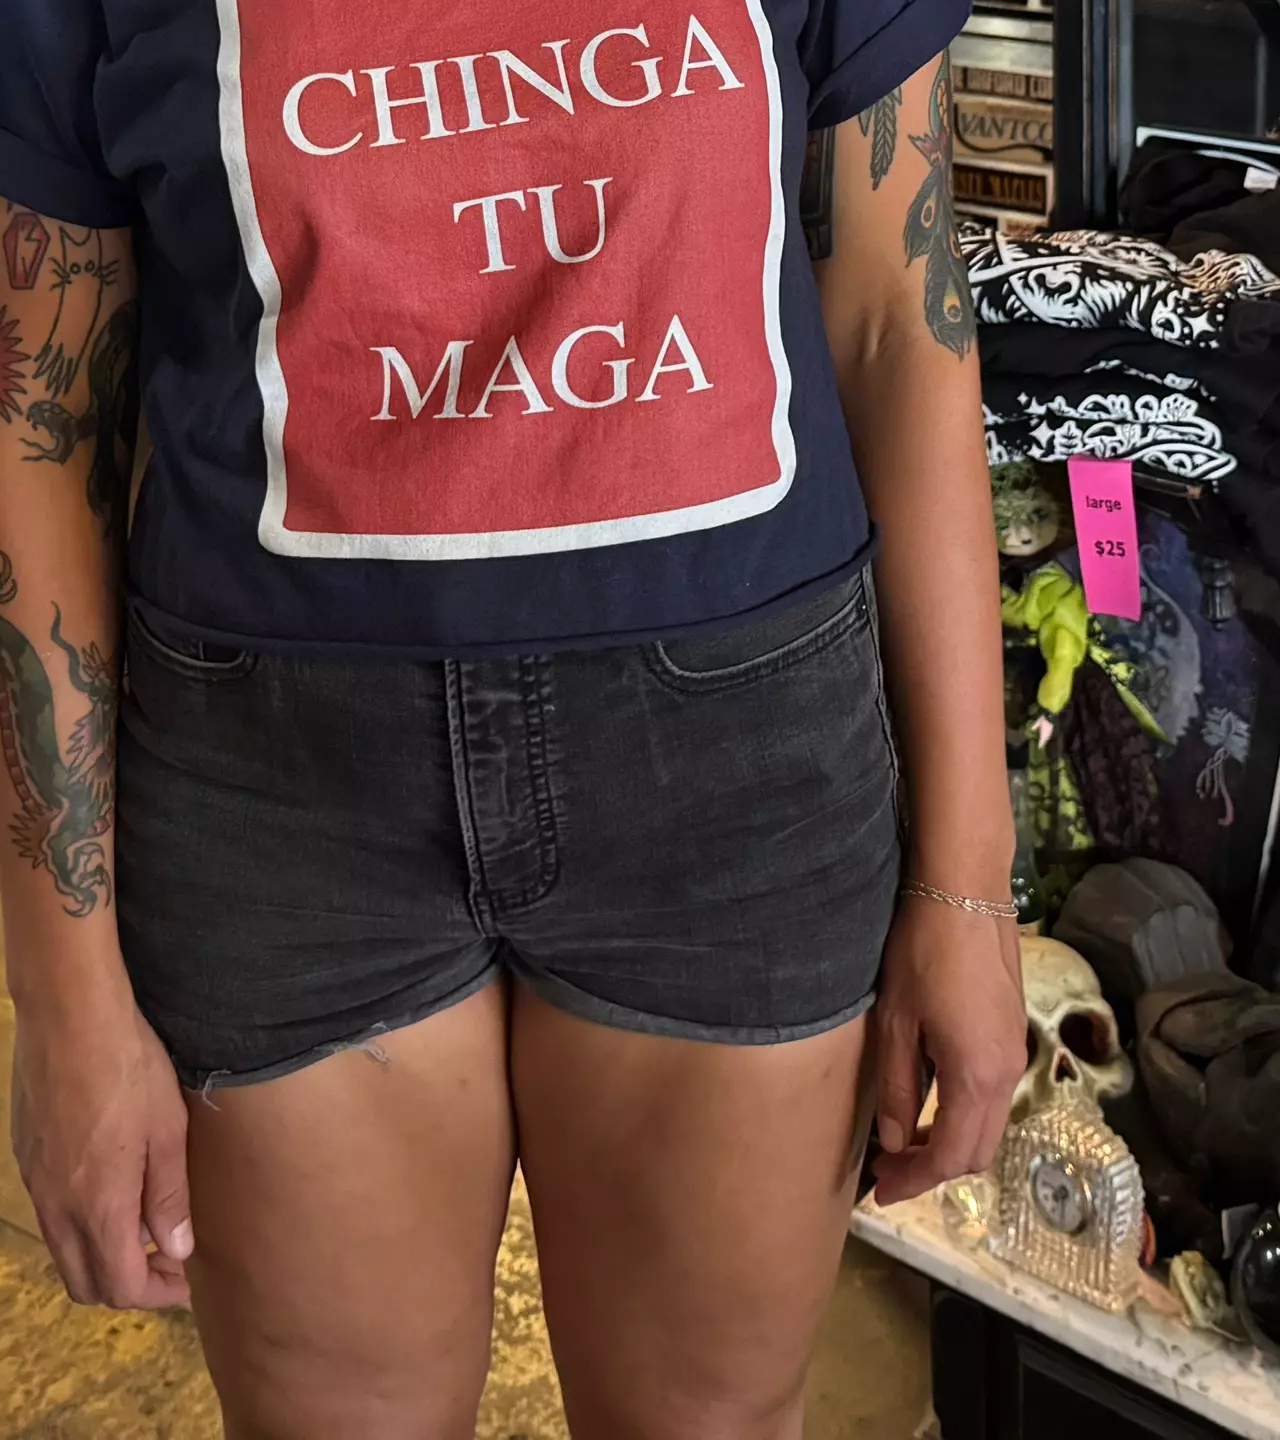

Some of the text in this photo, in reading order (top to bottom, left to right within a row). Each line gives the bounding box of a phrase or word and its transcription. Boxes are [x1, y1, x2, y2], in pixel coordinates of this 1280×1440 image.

[281, 13, 744, 156] CHINGA
[454, 176, 613, 275] TU
[369, 314, 714, 422] MAGA
[1085, 495, 1121, 512] large
[1094, 539, 1126, 558] $25
